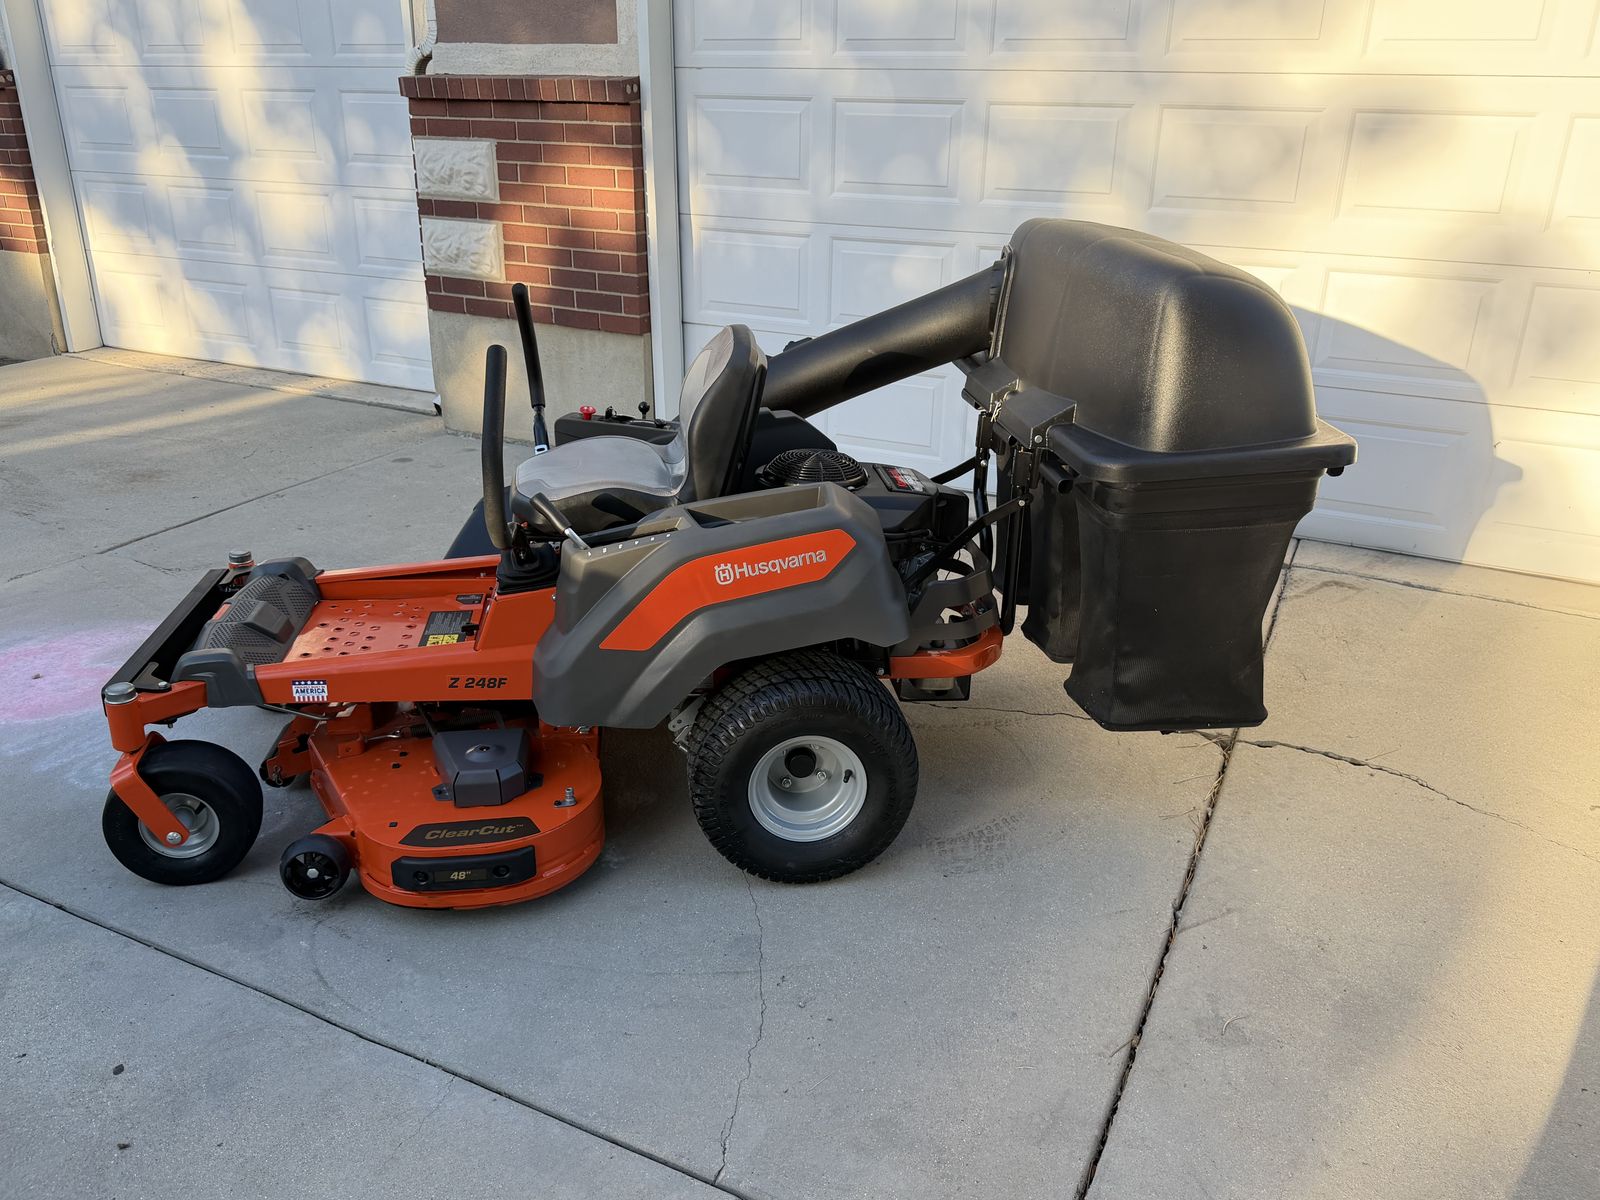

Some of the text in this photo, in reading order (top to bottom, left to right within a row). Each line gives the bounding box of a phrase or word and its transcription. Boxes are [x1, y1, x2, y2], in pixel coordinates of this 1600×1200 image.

[734, 549, 827, 579] Husqvarna
[448, 677, 508, 689] Z 248F
